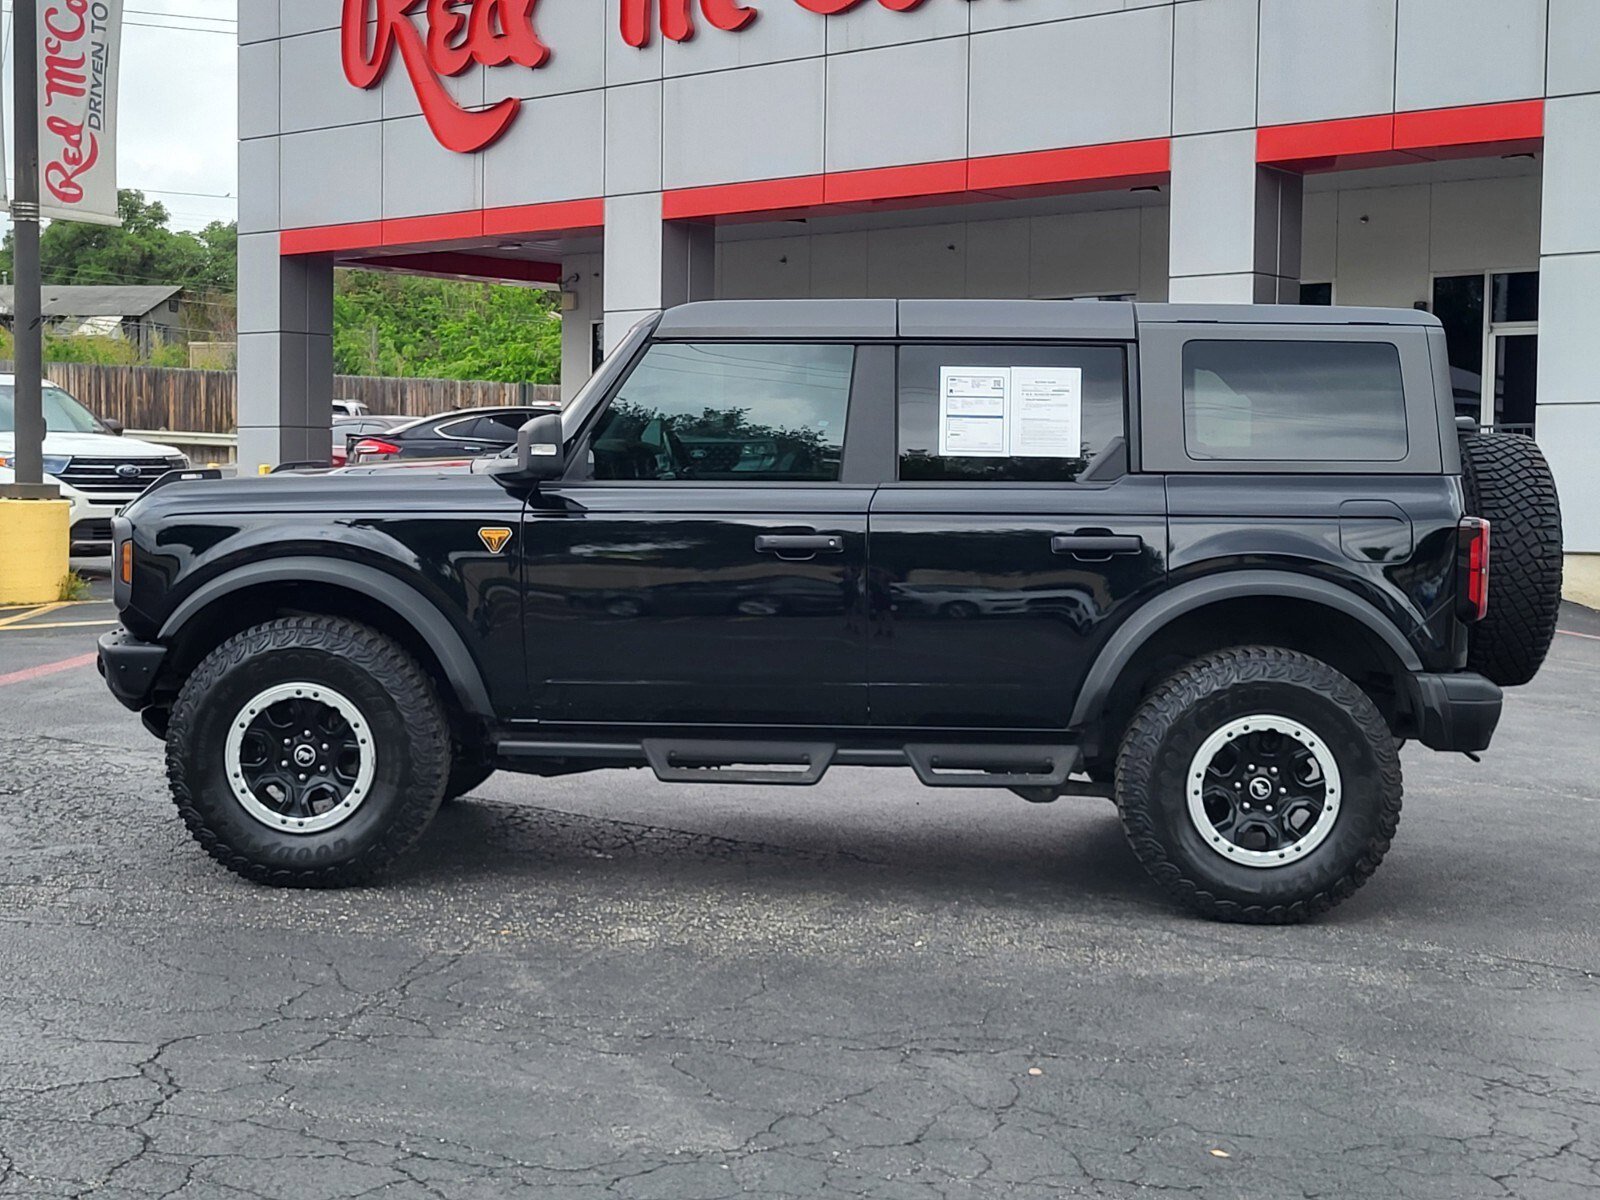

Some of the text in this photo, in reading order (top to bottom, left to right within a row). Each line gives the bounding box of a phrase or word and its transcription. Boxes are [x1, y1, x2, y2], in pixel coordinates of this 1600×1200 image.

[88, 2, 108, 131] DRIVEN TO
[45, 115, 99, 204] Red
